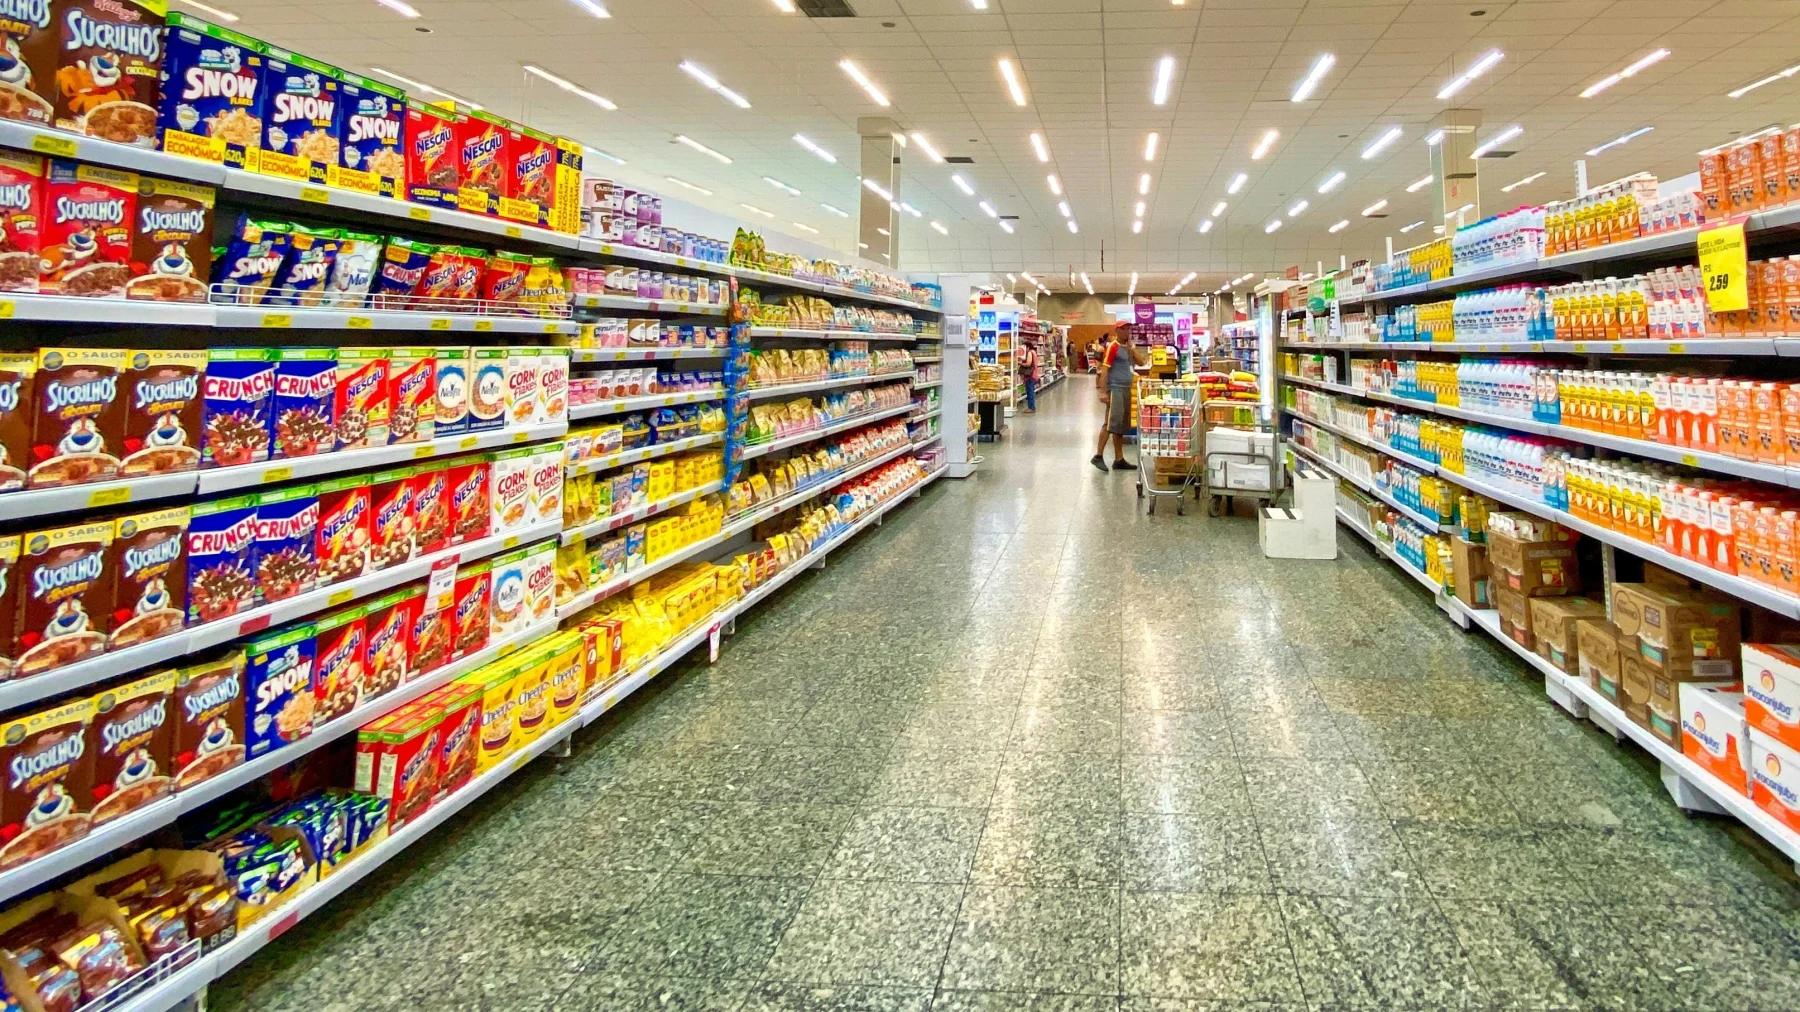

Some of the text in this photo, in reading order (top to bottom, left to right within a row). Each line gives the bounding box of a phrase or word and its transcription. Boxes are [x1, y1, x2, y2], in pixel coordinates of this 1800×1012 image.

[67, 11, 160, 63] SUCRILHOS
[183, 67, 257, 99] SNOW
[273, 93, 334, 122] SNOW
[168, 131, 211, 146] EMBALAGEM
[349, 115, 399, 142] SNOW
[416, 127, 452, 155] NESCAU
[166, 140, 222, 161] ECONÔMICA
[262, 152, 297, 164] EMBALAGEM
[462, 134, 502, 164] NESCAU
[261, 161, 308, 178] ECONÔMICA
[516, 149, 551, 179] NESCAU
[173, 182, 214, 198] SABOR
[339, 177, 378, 192] ECONÔMICA
[56, 196, 125, 224] SUCRILHOS
[142, 207, 205, 233] SUCRILHOS
[229, 255, 284, 278] SNOW
[424, 264, 456, 289] NESCAU
[493, 271, 525, 294] NESCAU
[1709, 273, 1729, 291] 2,59
[1, 355, 34, 363] BOR
[82, 351, 127, 359] SABOR
[204, 370, 273, 399] CRUNCH
[276, 369, 337, 397] CRUNCH
[346, 367, 384, 400] NESCAU
[399, 366, 432, 396] NESCAU
[509, 368, 536, 389] CORN
[513, 381, 537, 399] flakes
[541, 366, 564, 388] CORN
[47, 375, 118, 412] SUCRILHOS
[136, 375, 198, 408] SUCRILHOS
[453, 469, 485, 508] NESCAU
[497, 469, 525, 495] CORN
[533, 463, 558, 487] CORN
[415, 477, 445, 513] NESCAU
[502, 482, 528, 503] flakes
[153, 510, 189, 522] SABOR
[256, 506, 319, 539] CRUNCH
[321, 496, 367, 544] NESCAU
[377, 487, 413, 531] NESCAU
[68, 525, 113, 537] SABOR
[190, 517, 257, 554] CRUNCH
[125, 533, 182, 577] SUCRILHOS
[34, 550, 104, 598] SUCRILHOS
[528, 563, 552, 589] CORN
[456, 578, 489, 623] NESCAU
[368, 610, 404, 662] NESCAU
[318, 627, 362, 683] NESCAU
[119, 672, 174, 696] O SABOR
[255, 659, 312, 712] SNOW
[552, 663, 582, 687] Cheerios
[185, 673, 240, 722] SUCRILHOS
[518, 682, 549, 705] Cheerios
[1747, 685, 1792, 716] Piracanjuba
[30, 700, 93, 726] O SABOR
[103, 699, 166, 754] SUCRILHOS
[481, 700, 516, 727] Cheerios
[442, 705, 481, 762] NESCAU
[1683, 719, 1720, 750] Piracanjuba
[11, 728, 85, 789] SUCRILHOS
[400, 730, 441, 790] NESCAU
[1753, 769, 1797, 803] Piracanjuba
